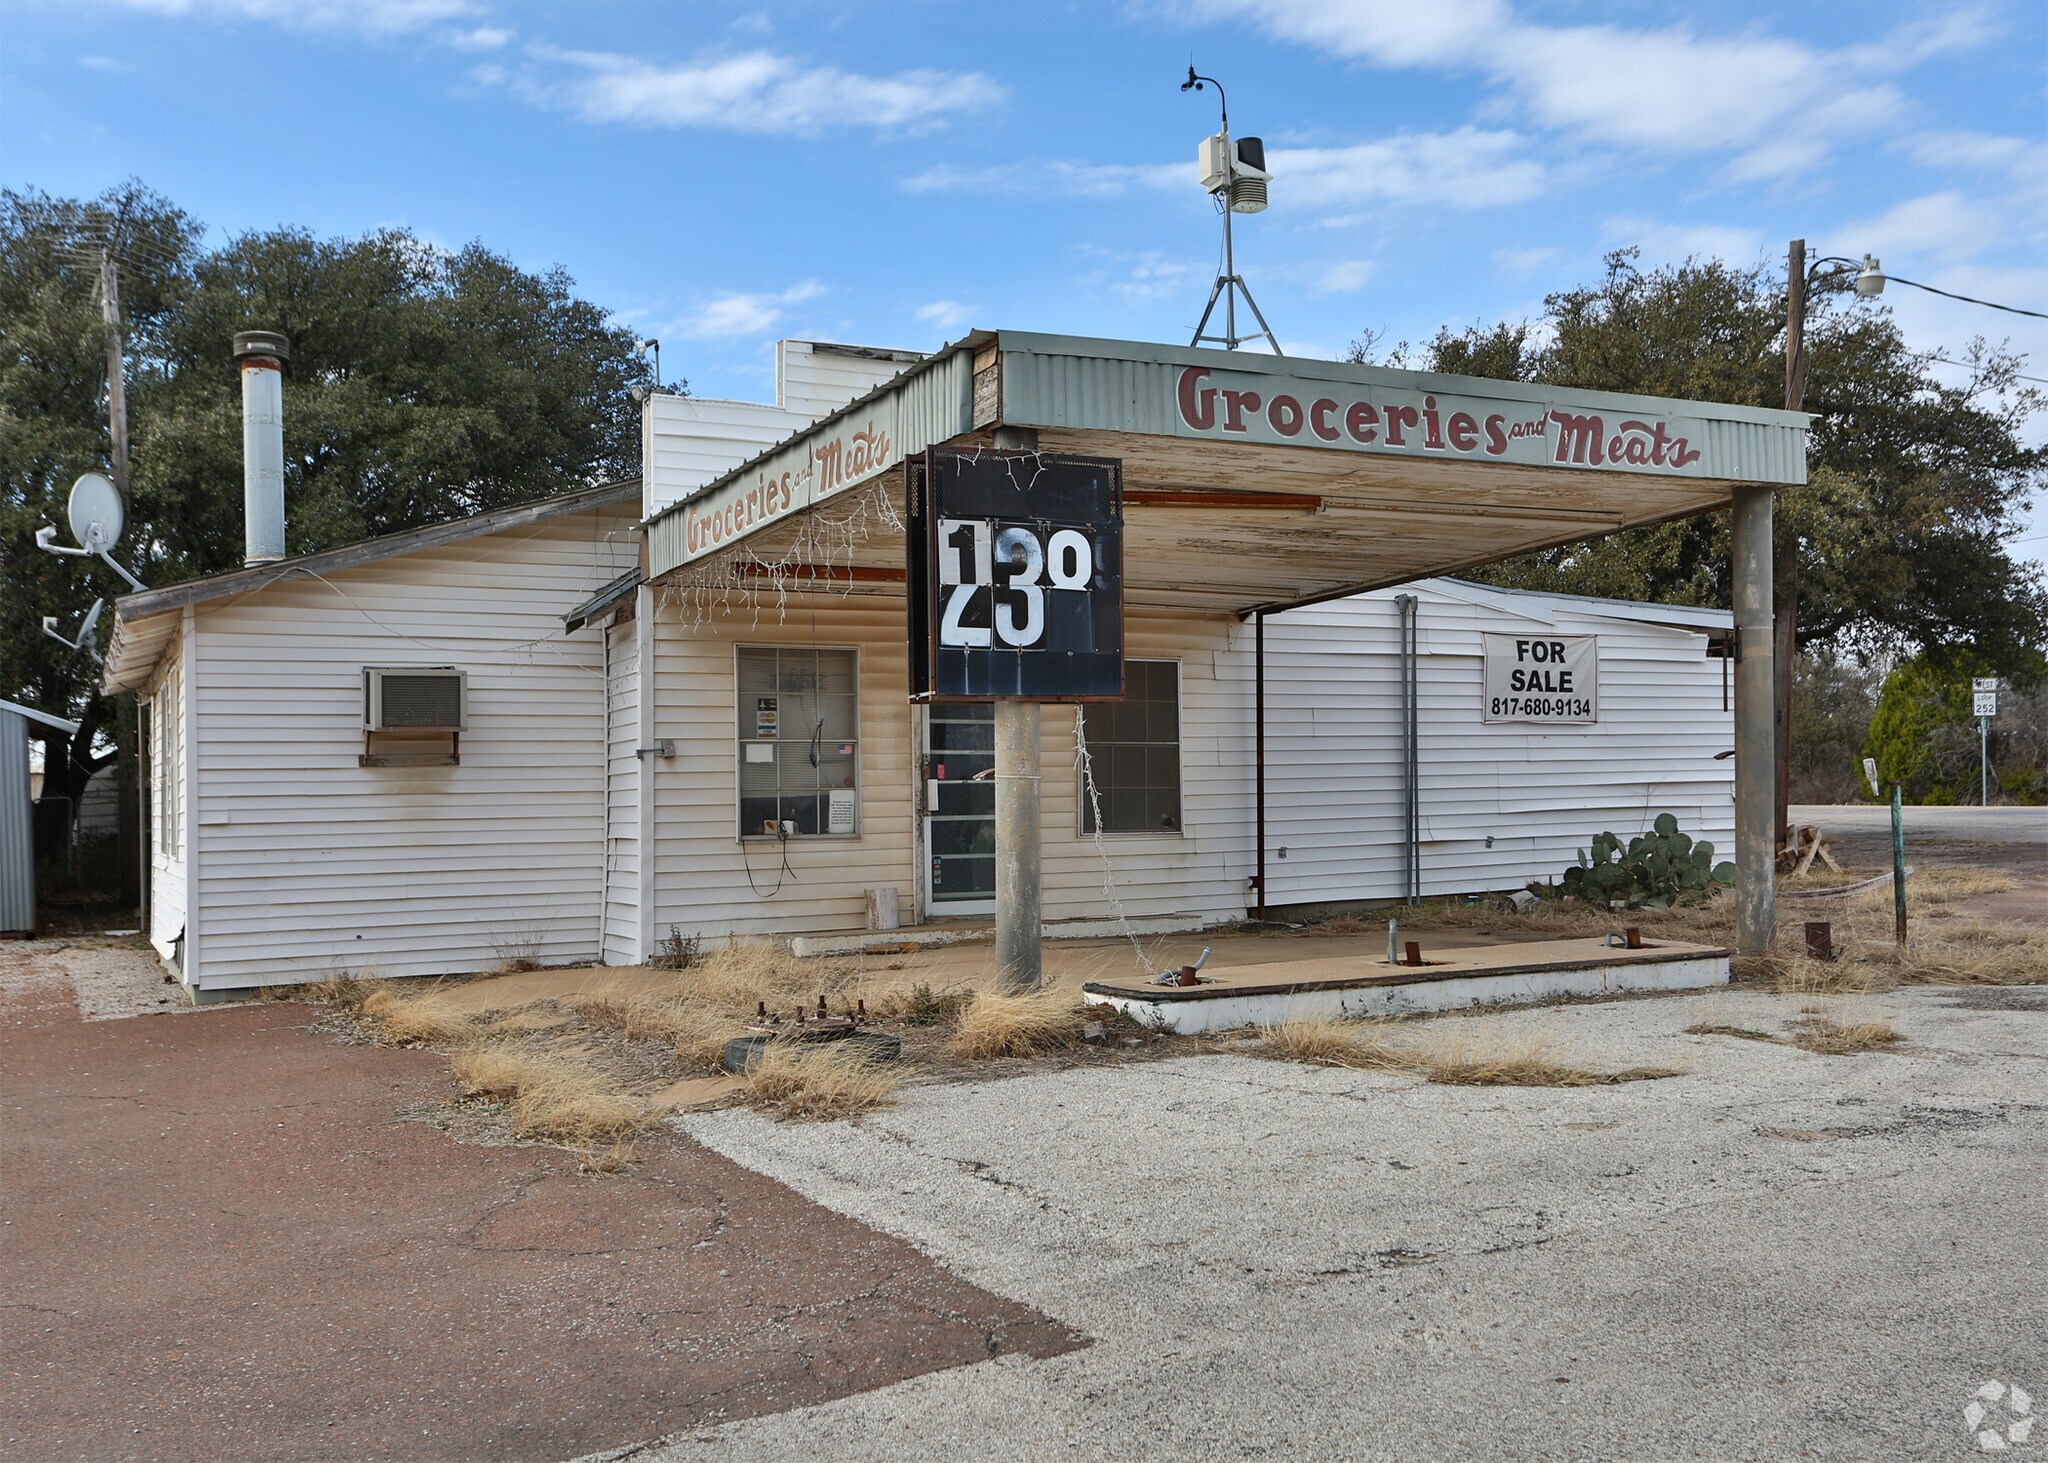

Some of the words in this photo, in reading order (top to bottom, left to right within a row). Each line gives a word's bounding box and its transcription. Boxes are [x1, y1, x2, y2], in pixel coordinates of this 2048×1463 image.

[1176, 366, 1509, 456] Groceries
[1508, 411, 1549, 440] and
[1549, 409, 1701, 469] Meats
[687, 471, 791, 555] Groceries
[792, 463, 813, 492] and
[814, 420, 890, 496] Meats
[1516, 640, 1566, 663] FOR
[1510, 669, 1574, 693] SALE
[1491, 697, 1591, 716] 817-680-9134
[1976, 704, 1994, 713] 252
